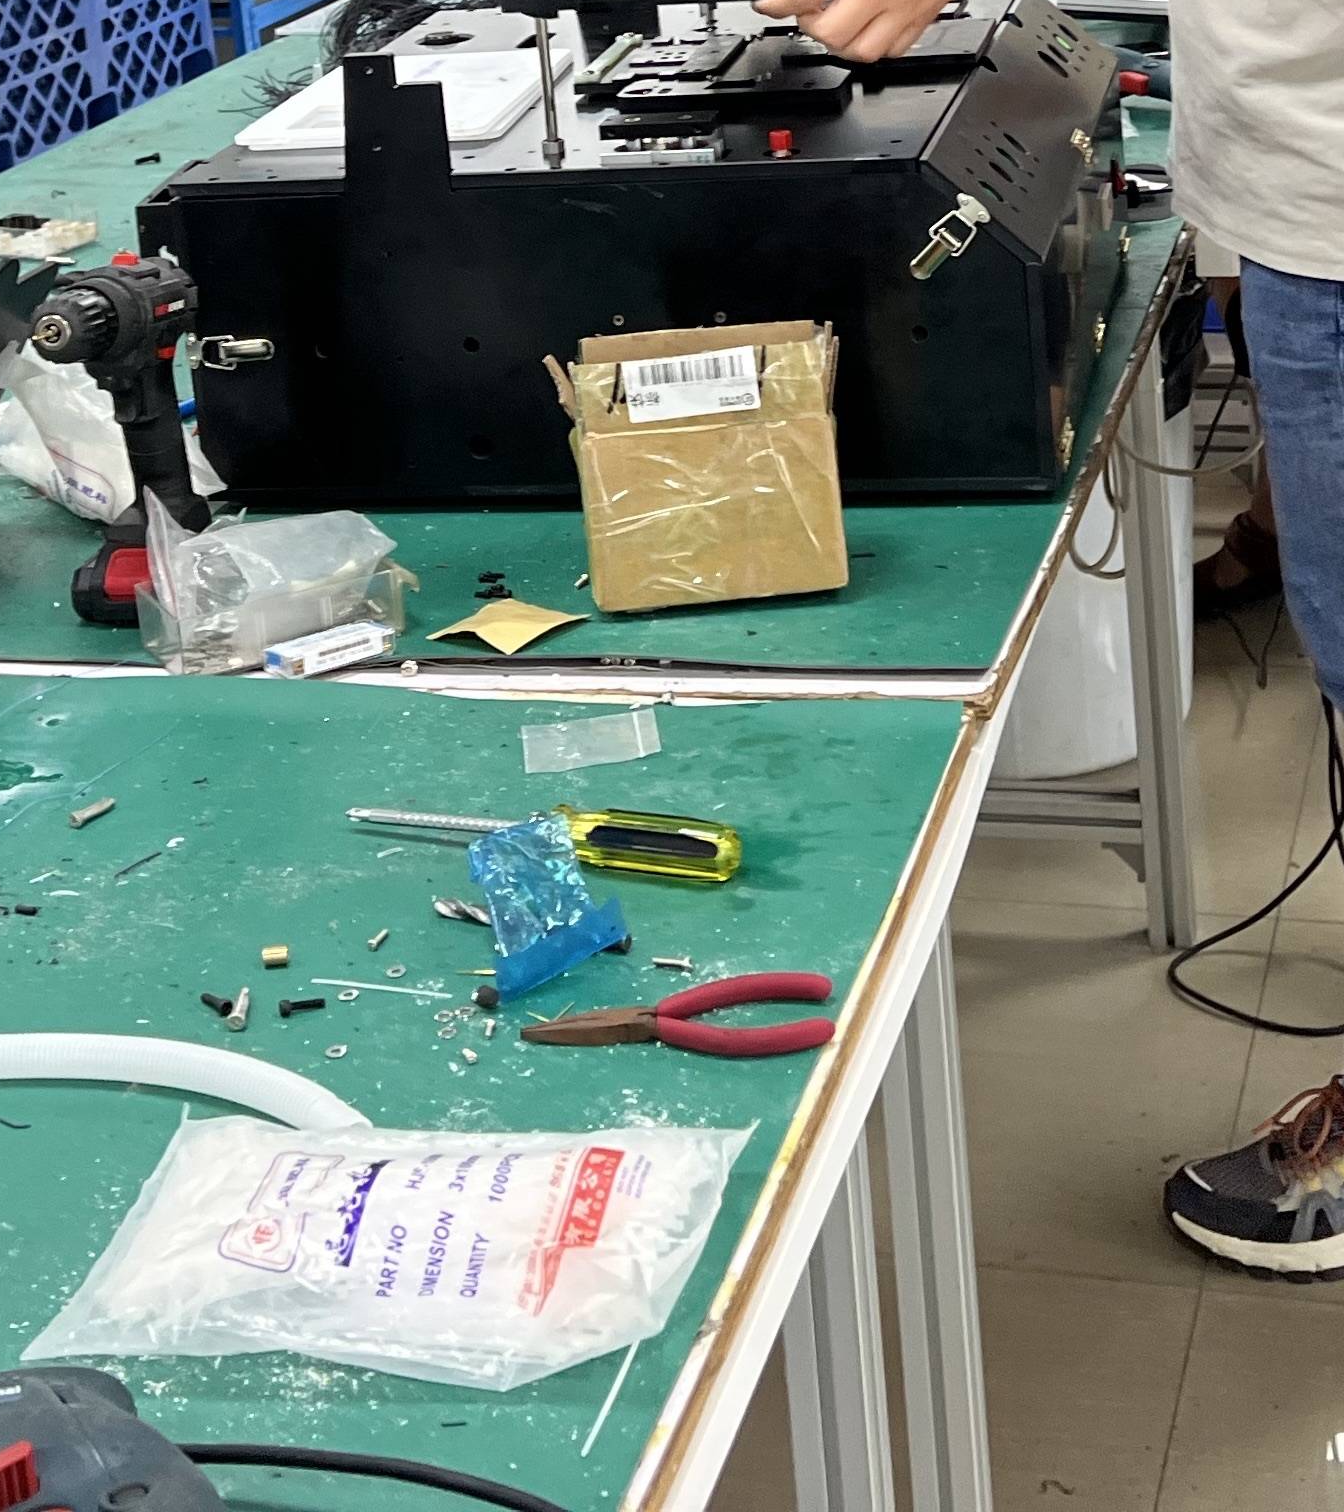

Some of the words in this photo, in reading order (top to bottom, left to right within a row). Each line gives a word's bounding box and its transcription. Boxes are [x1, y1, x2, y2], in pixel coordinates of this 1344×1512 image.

[387, 1225, 408, 1255] NO
[418, 1210, 455, 1297] DIMENSION
[459, 1232, 491, 1298] QUANTITY
[375, 1255, 401, 1298] PART
